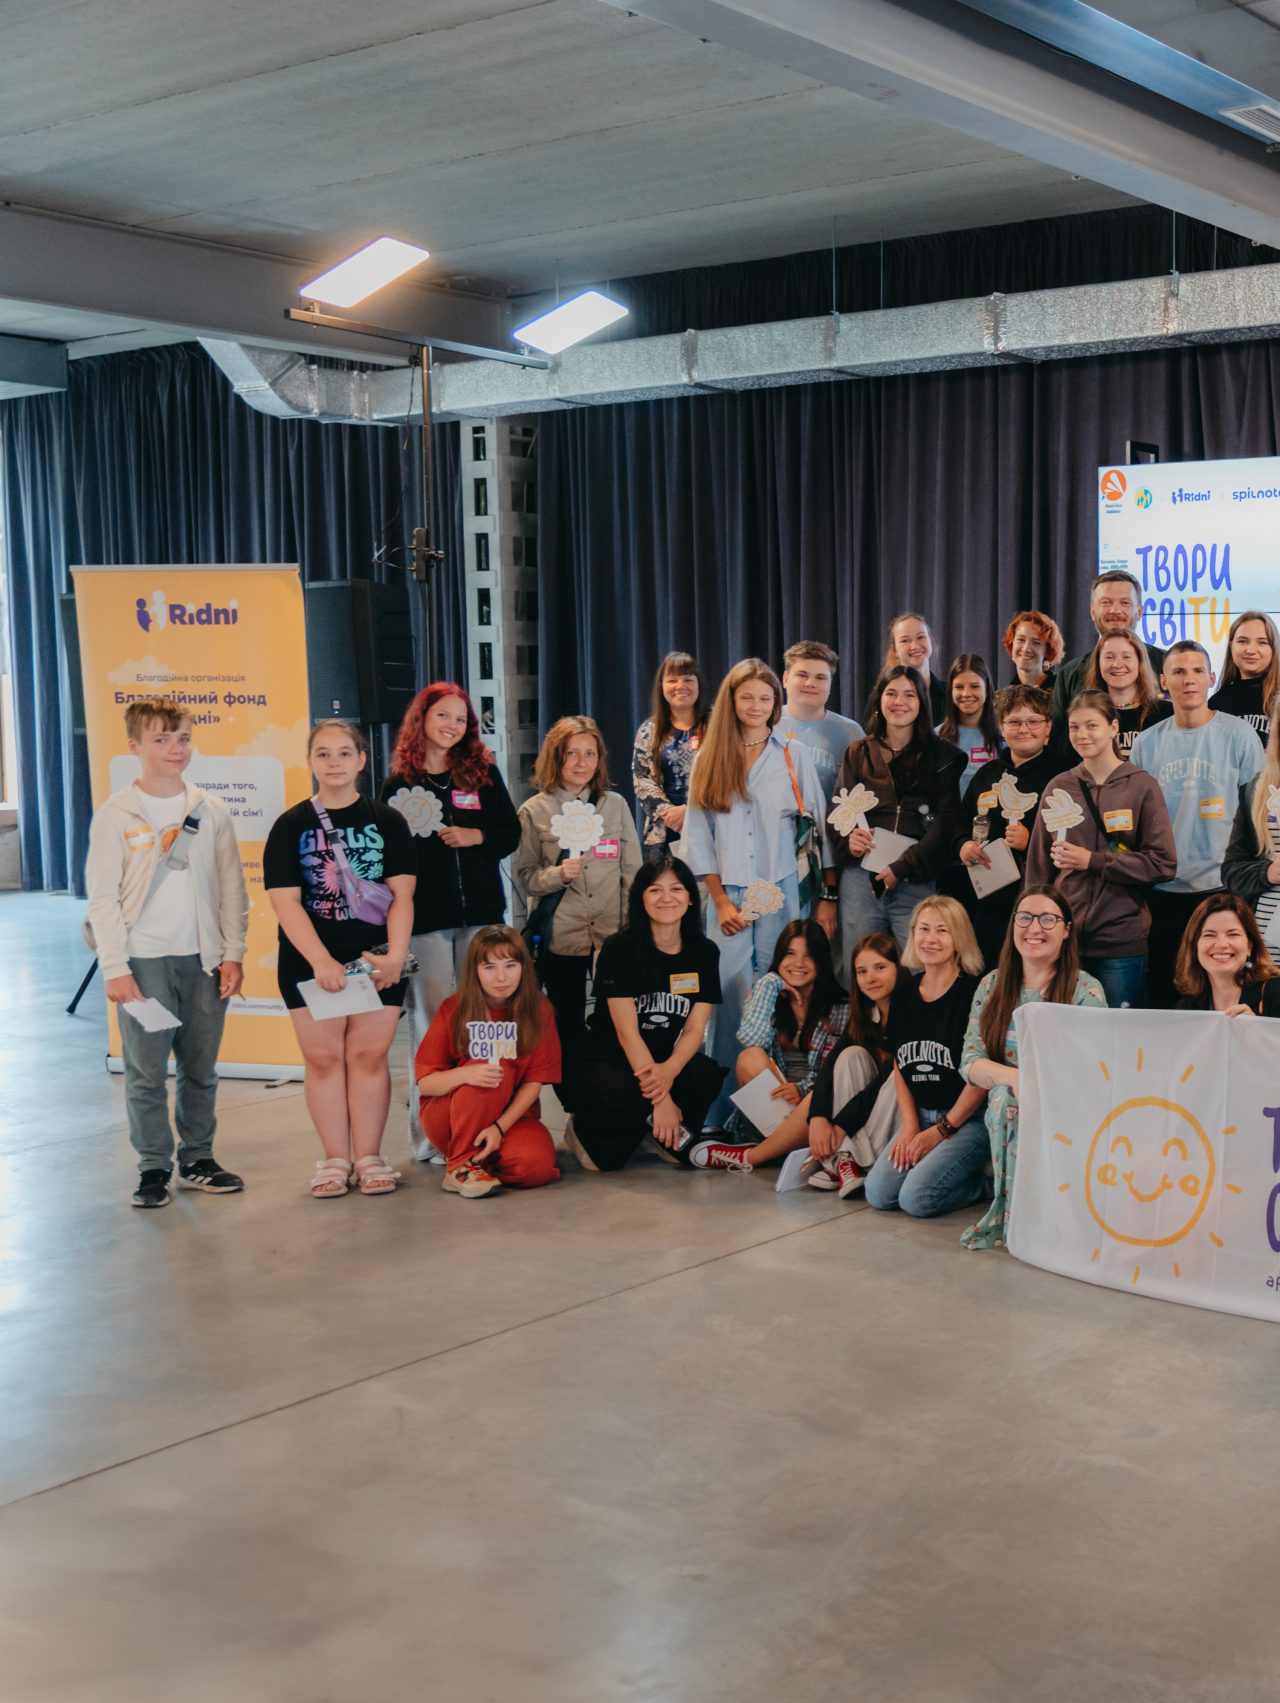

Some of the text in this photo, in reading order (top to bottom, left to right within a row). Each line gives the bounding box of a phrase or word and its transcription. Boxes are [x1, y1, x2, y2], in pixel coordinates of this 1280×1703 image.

[1184, 490, 1211, 502] Ridni
[1135, 543, 1232, 592] ТВОРИ
[168, 599, 239, 625] Ridni
[1142, 596, 1230, 646] СВІТИ
[136, 673, 246, 683] Благодійна організація
[223, 692, 267, 707] фонд
[232, 783, 257, 791] того,
[468, 1023, 516, 1040] ТВОРИ
[471, 1041, 516, 1058] СВІТИ
[897, 1040, 956, 1070] SPILNOTA
